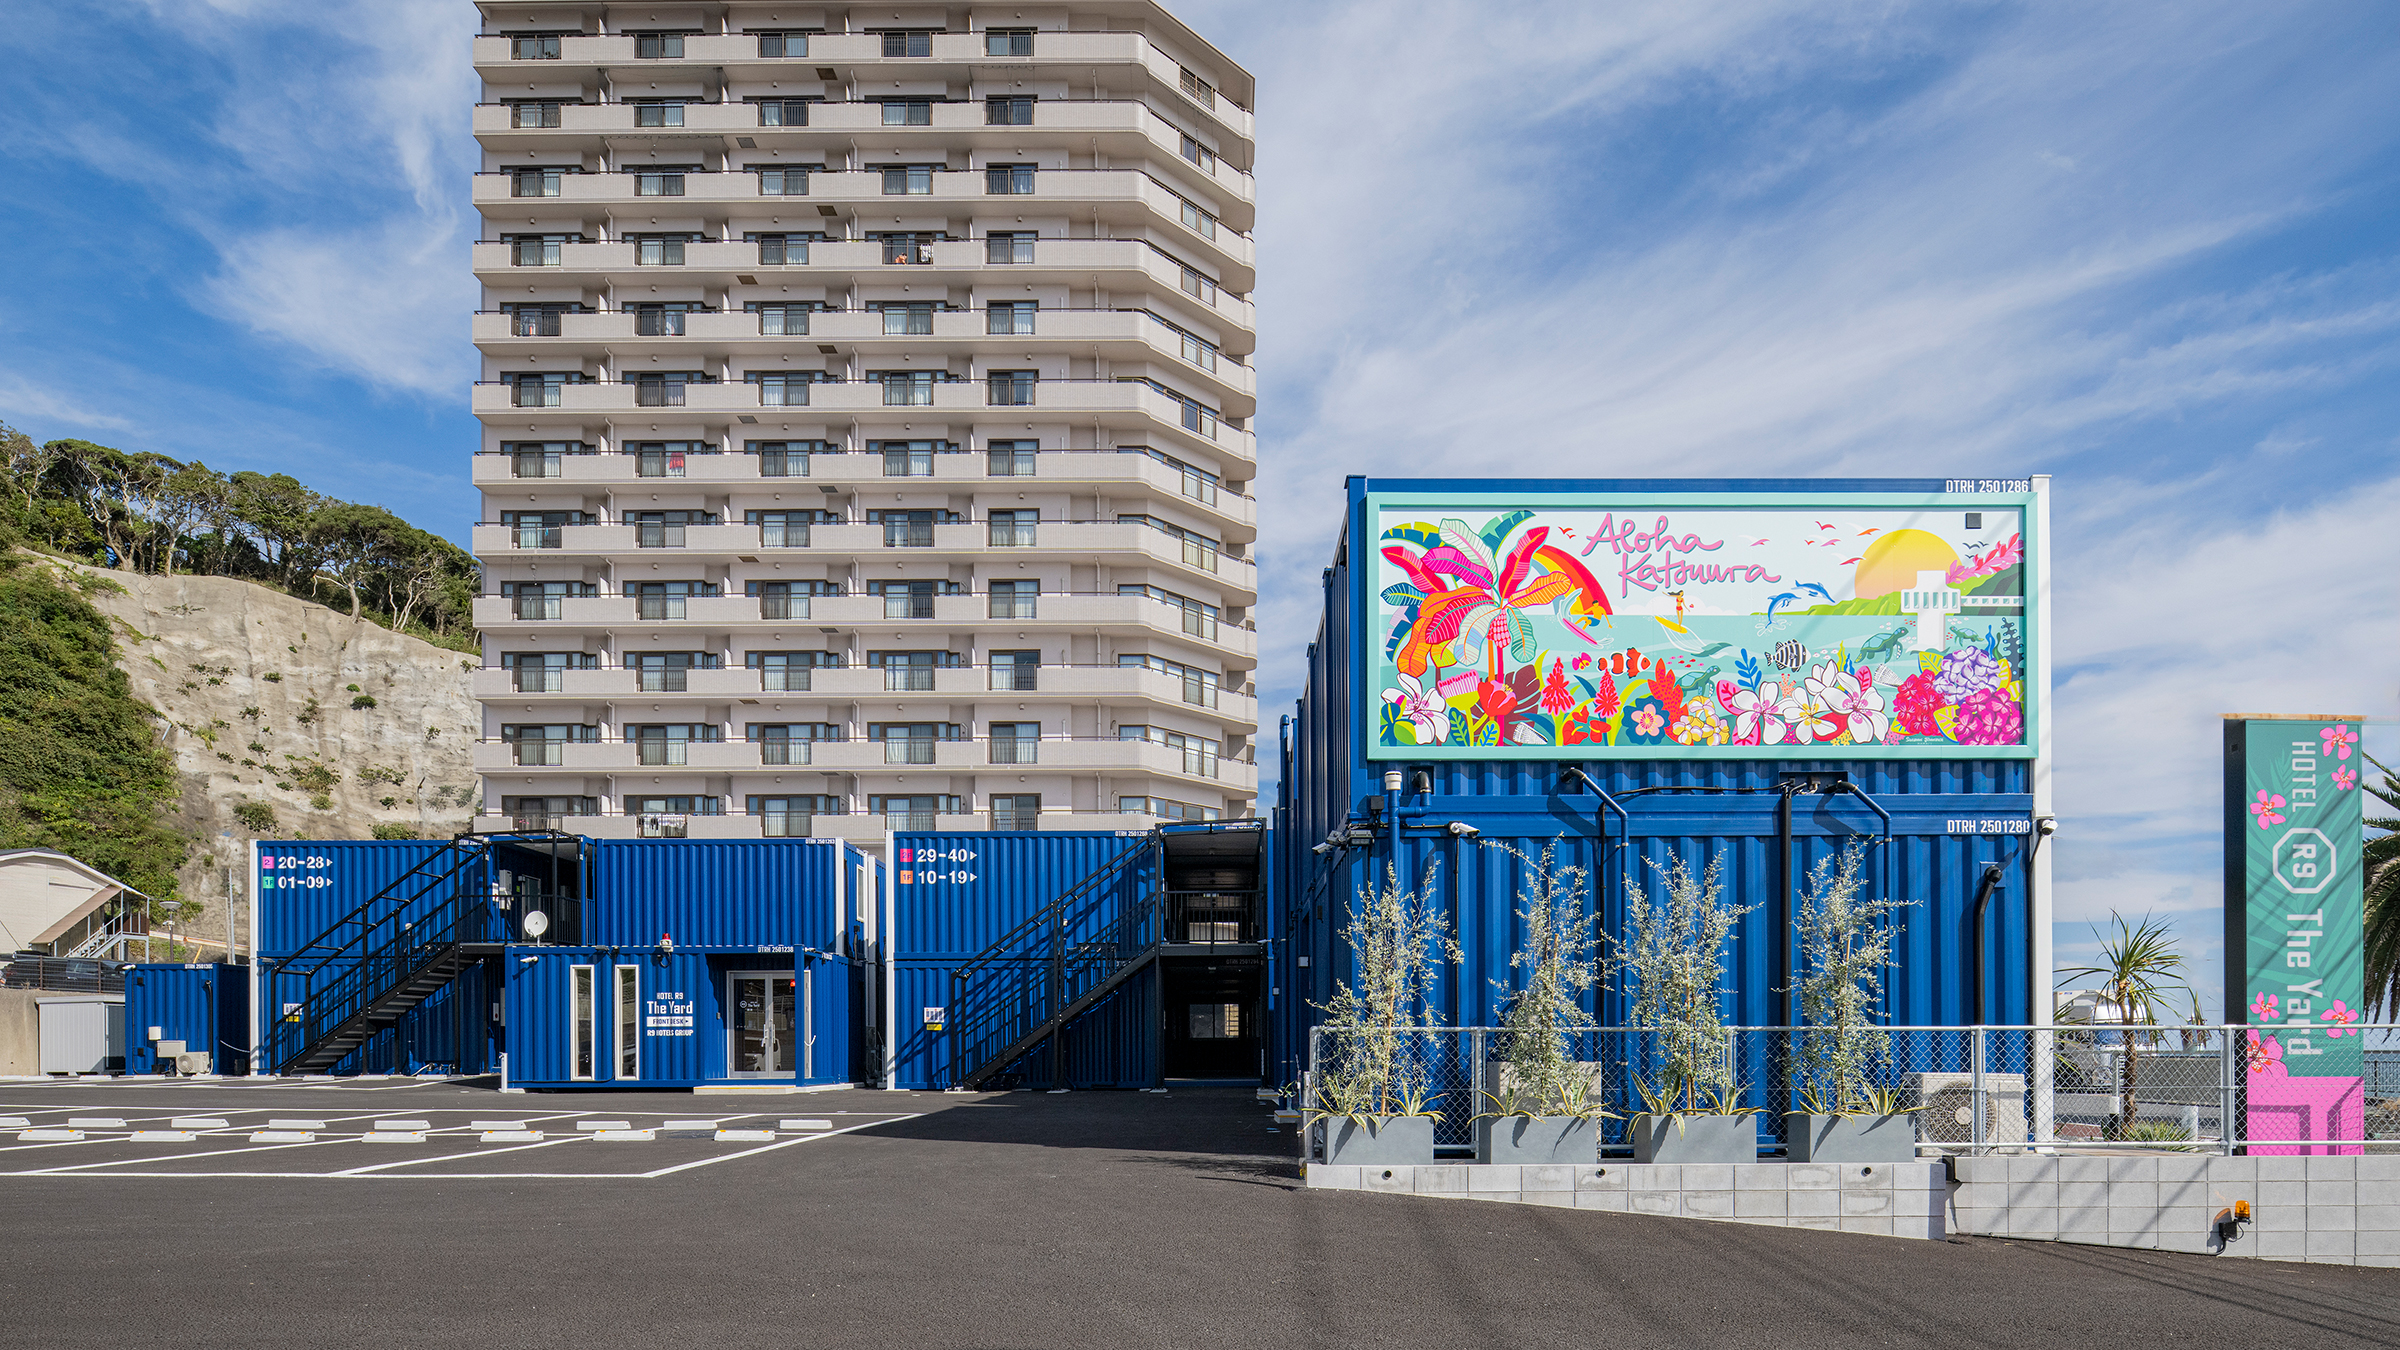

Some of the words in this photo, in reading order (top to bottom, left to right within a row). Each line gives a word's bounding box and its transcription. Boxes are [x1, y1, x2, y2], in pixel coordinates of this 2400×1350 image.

[1946, 480, 1975, 493] DTRH
[1978, 480, 2029, 493] 2501286
[1581, 512, 1724, 557] Aloha
[1618, 550, 1781, 599] Katsuura
[2292, 742, 2316, 812] HOTEL
[1947, 819, 1976, 833] DTRH
[1980, 819, 2031, 833] 2501280
[278, 856, 324, 869] 20-28
[917, 848, 968, 863] 29-40
[2292, 843, 2317, 878] R9
[278, 876, 324, 889] 01-09
[918, 870, 968, 884] 10-19
[2287, 908, 2323, 968] The
[656, 992, 673, 1000] HOTEL
[674, 992, 684, 1000] R9
[646, 1001, 667, 1014] The
[668, 1001, 693, 1014] Yard
[2287, 978, 2323, 1055] Yard
[656, 1029, 674, 1037] HOTELS
[674, 1029, 694, 1037] GROUP
